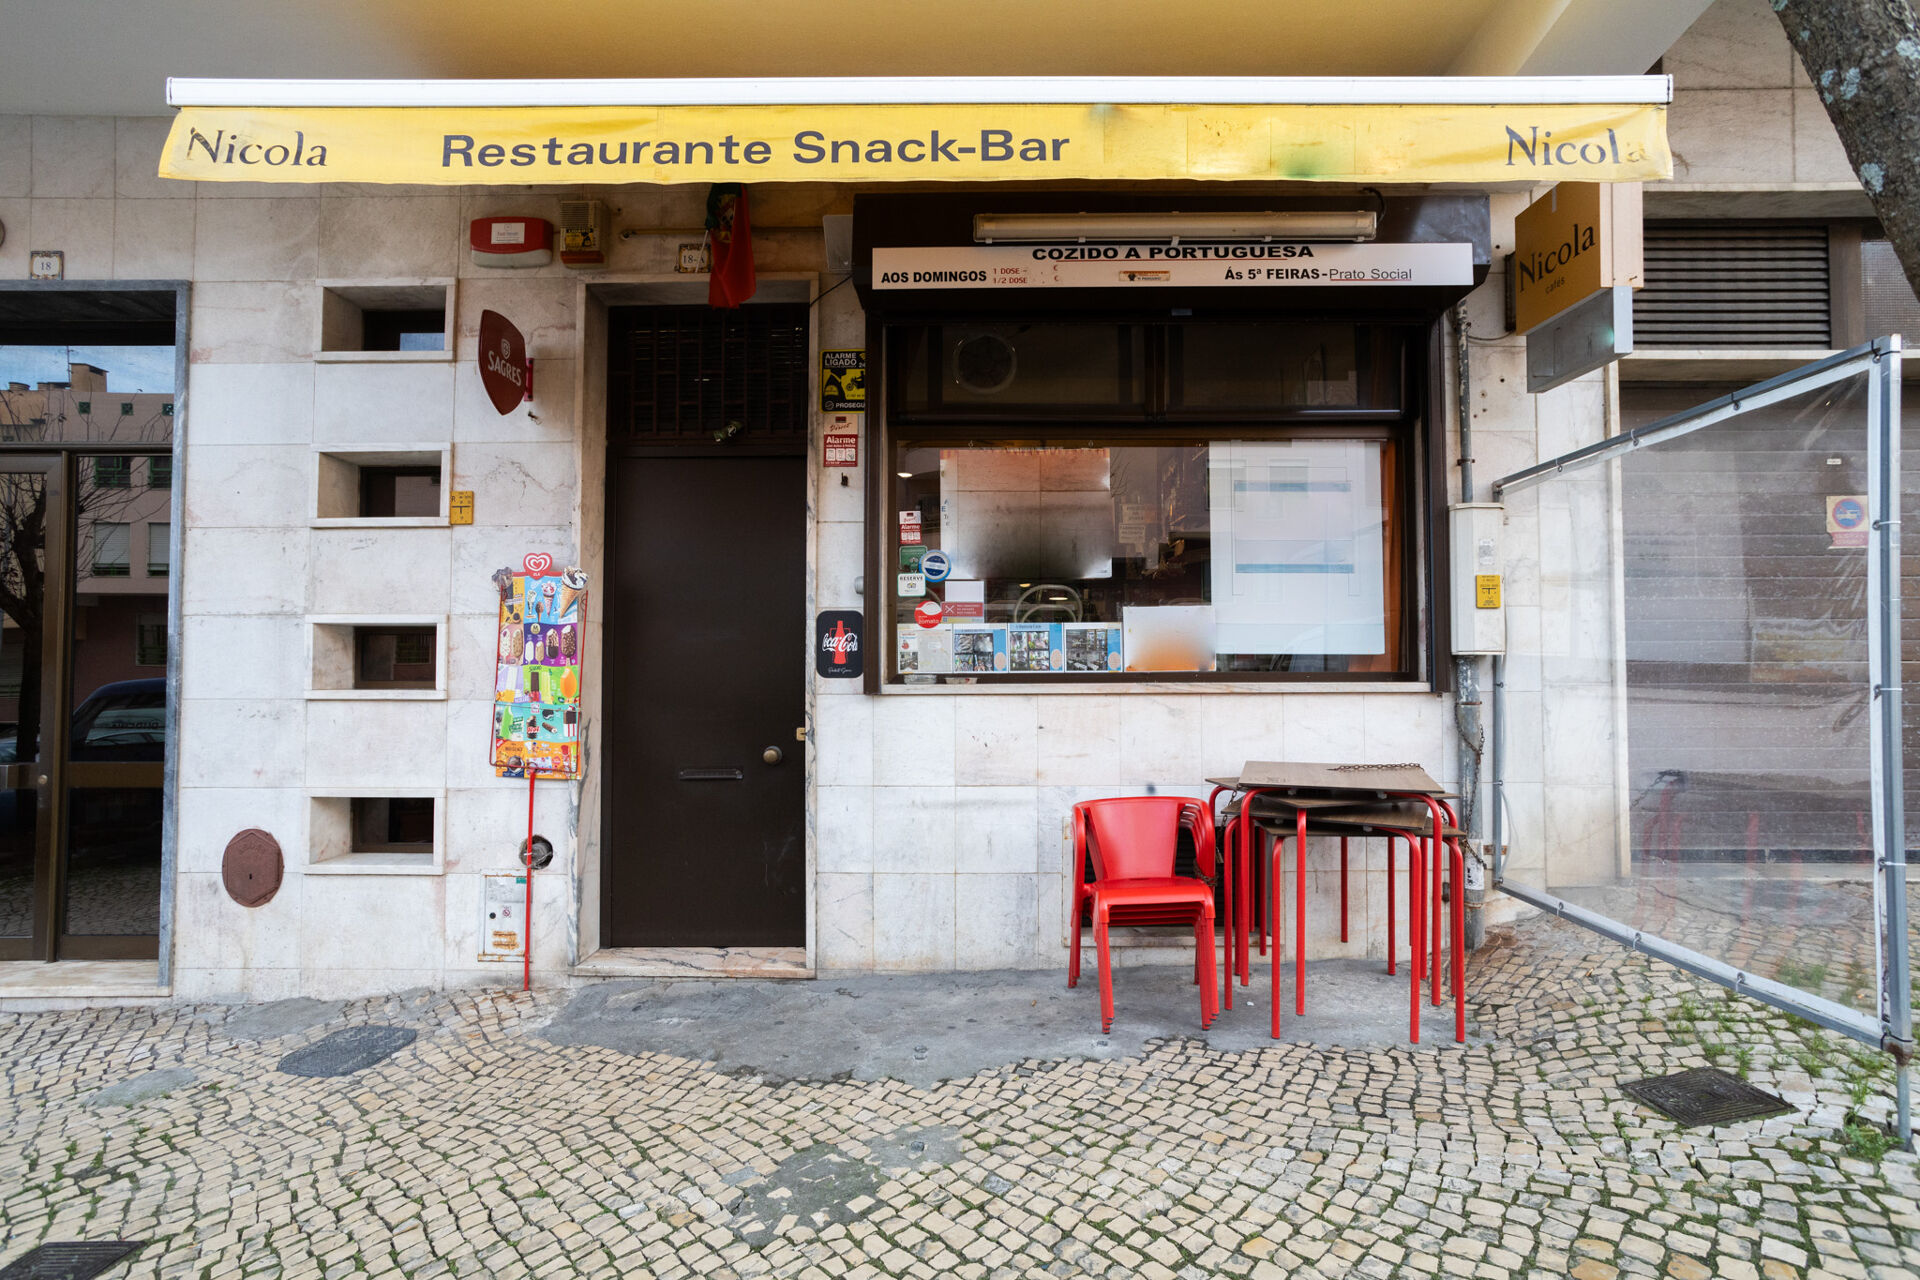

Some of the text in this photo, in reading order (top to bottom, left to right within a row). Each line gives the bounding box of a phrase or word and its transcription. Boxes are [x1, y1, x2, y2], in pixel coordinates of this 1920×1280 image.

[186, 126, 327, 168] Nicola
[441, 129, 1070, 168] Restaurante Snack-Bar
[1506, 125, 1650, 166] Nicola
[1032, 246, 1314, 260] COZIDO A PORTUGUESA
[1519, 223, 1596, 293] Nicola
[41, 261, 52, 271] 18
[881, 270, 987, 283] AOS DOMINGOS
[1225, 265, 1243, 280] Ás
[1247, 268, 1262, 280] 5ª
[1370, 268, 1412, 280] Social
[487, 350, 522, 386] SAGRES
[826, 436, 856, 444] Alarme
